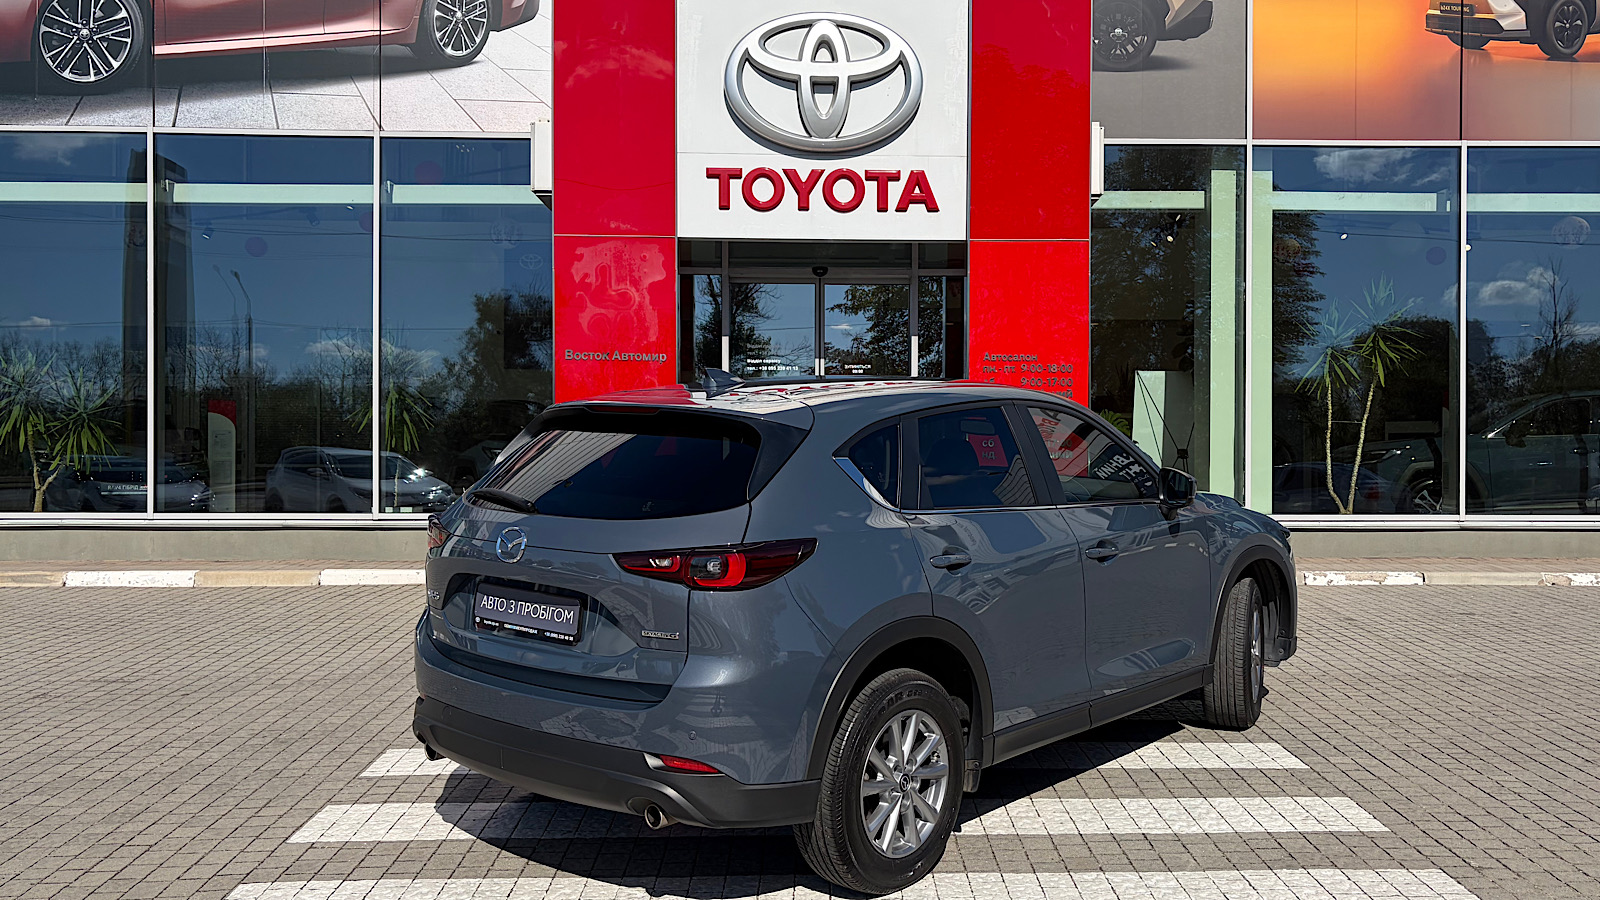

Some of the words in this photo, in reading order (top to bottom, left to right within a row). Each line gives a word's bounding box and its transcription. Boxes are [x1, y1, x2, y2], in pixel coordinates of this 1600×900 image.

[706, 167, 940, 213] TOYOTA
[565, 349, 610, 361] Восток
[612, 350, 667, 364] Автомир
[983, 352, 1038, 362] Автосалон
[1021, 363, 1073, 373] 9:00-18:00
[1021, 377, 1073, 387] 9:00-17:00
[480, 595, 507, 612] АВТО
[516, 601, 574, 624] ПРОБІГОМ
